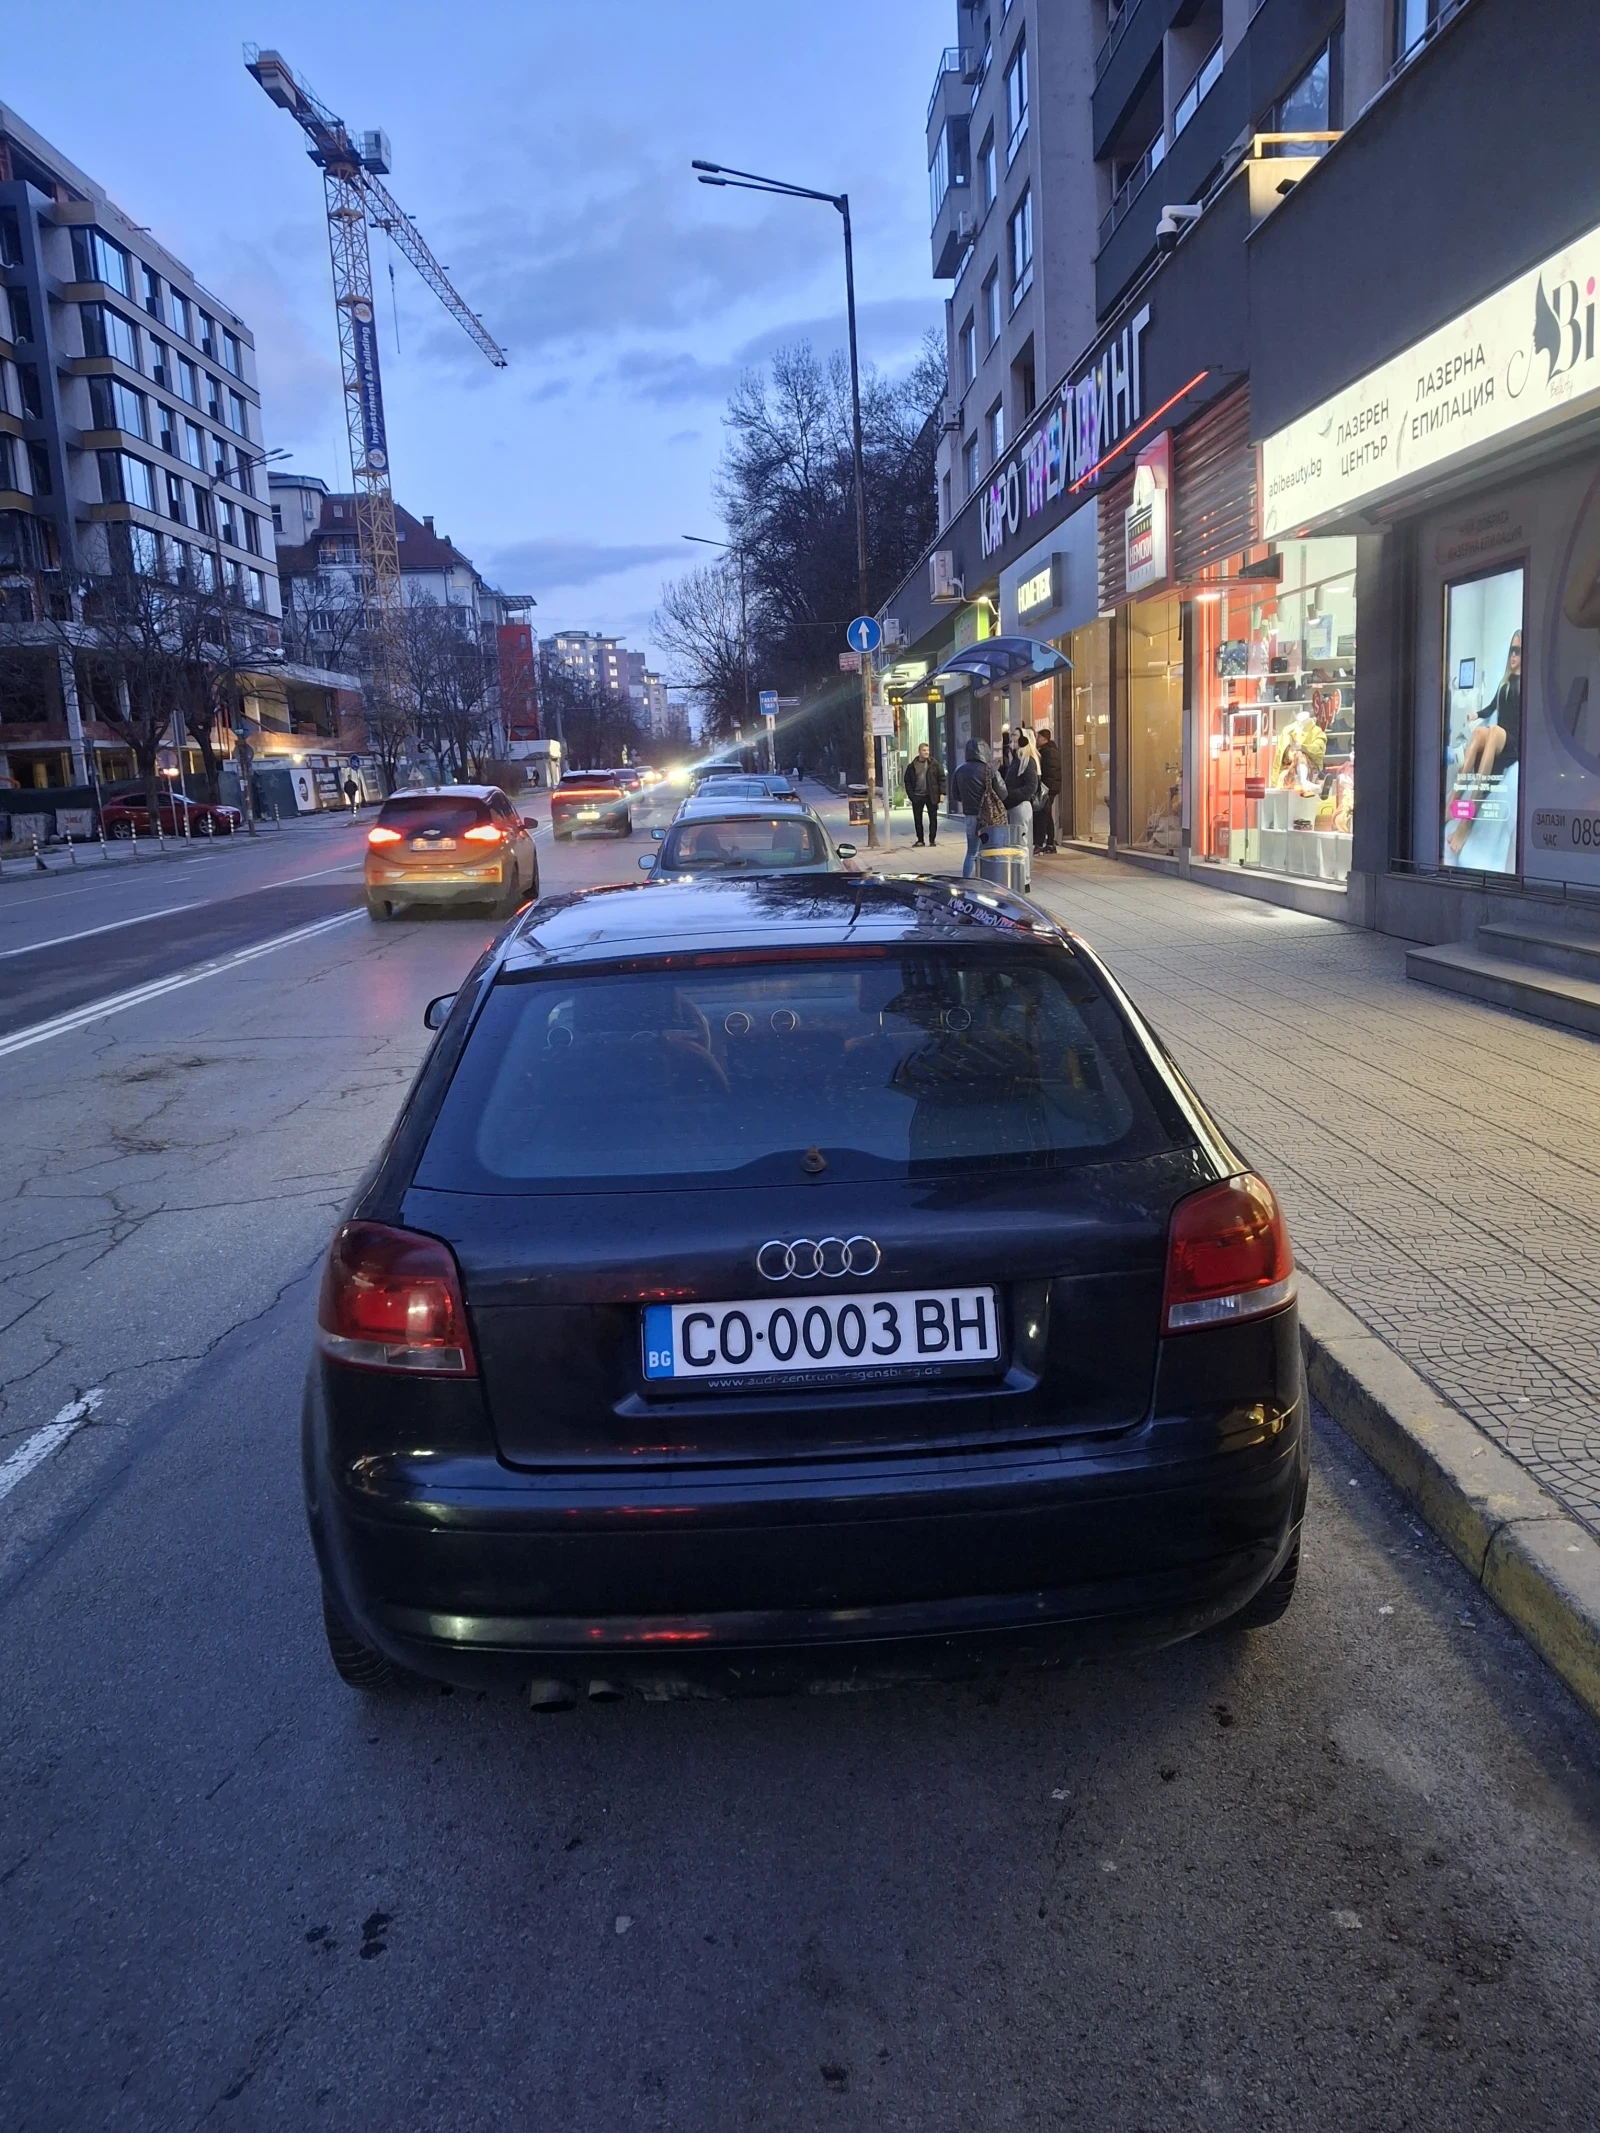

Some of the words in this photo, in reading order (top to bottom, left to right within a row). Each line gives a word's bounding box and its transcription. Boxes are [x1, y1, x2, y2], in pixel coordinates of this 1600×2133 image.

[361, 326, 374, 371] Building
[1416, 342, 1486, 402] ЛАЗЕРНА
[367, 382, 379, 444] Investment
[1336, 397, 1389, 447] ЛАЗЕРЕН
[1412, 376, 1494, 440] ЕПИЛАЦИЯ
[980, 460, 1020, 559] КАРО
[1021, 303, 1150, 518] ТРЕЙДИНГ
[1268, 457, 1322, 498] abibeauty.bg
[1341, 434, 1388, 477] ЦЕНТЪР
[1313, 692, 1340, 722] SALE
[1536, 813, 1566, 827] ЗАПАЗИ
[1543, 832, 1558, 847] ЧАС
[648, 1350, 672, 1369] BG
